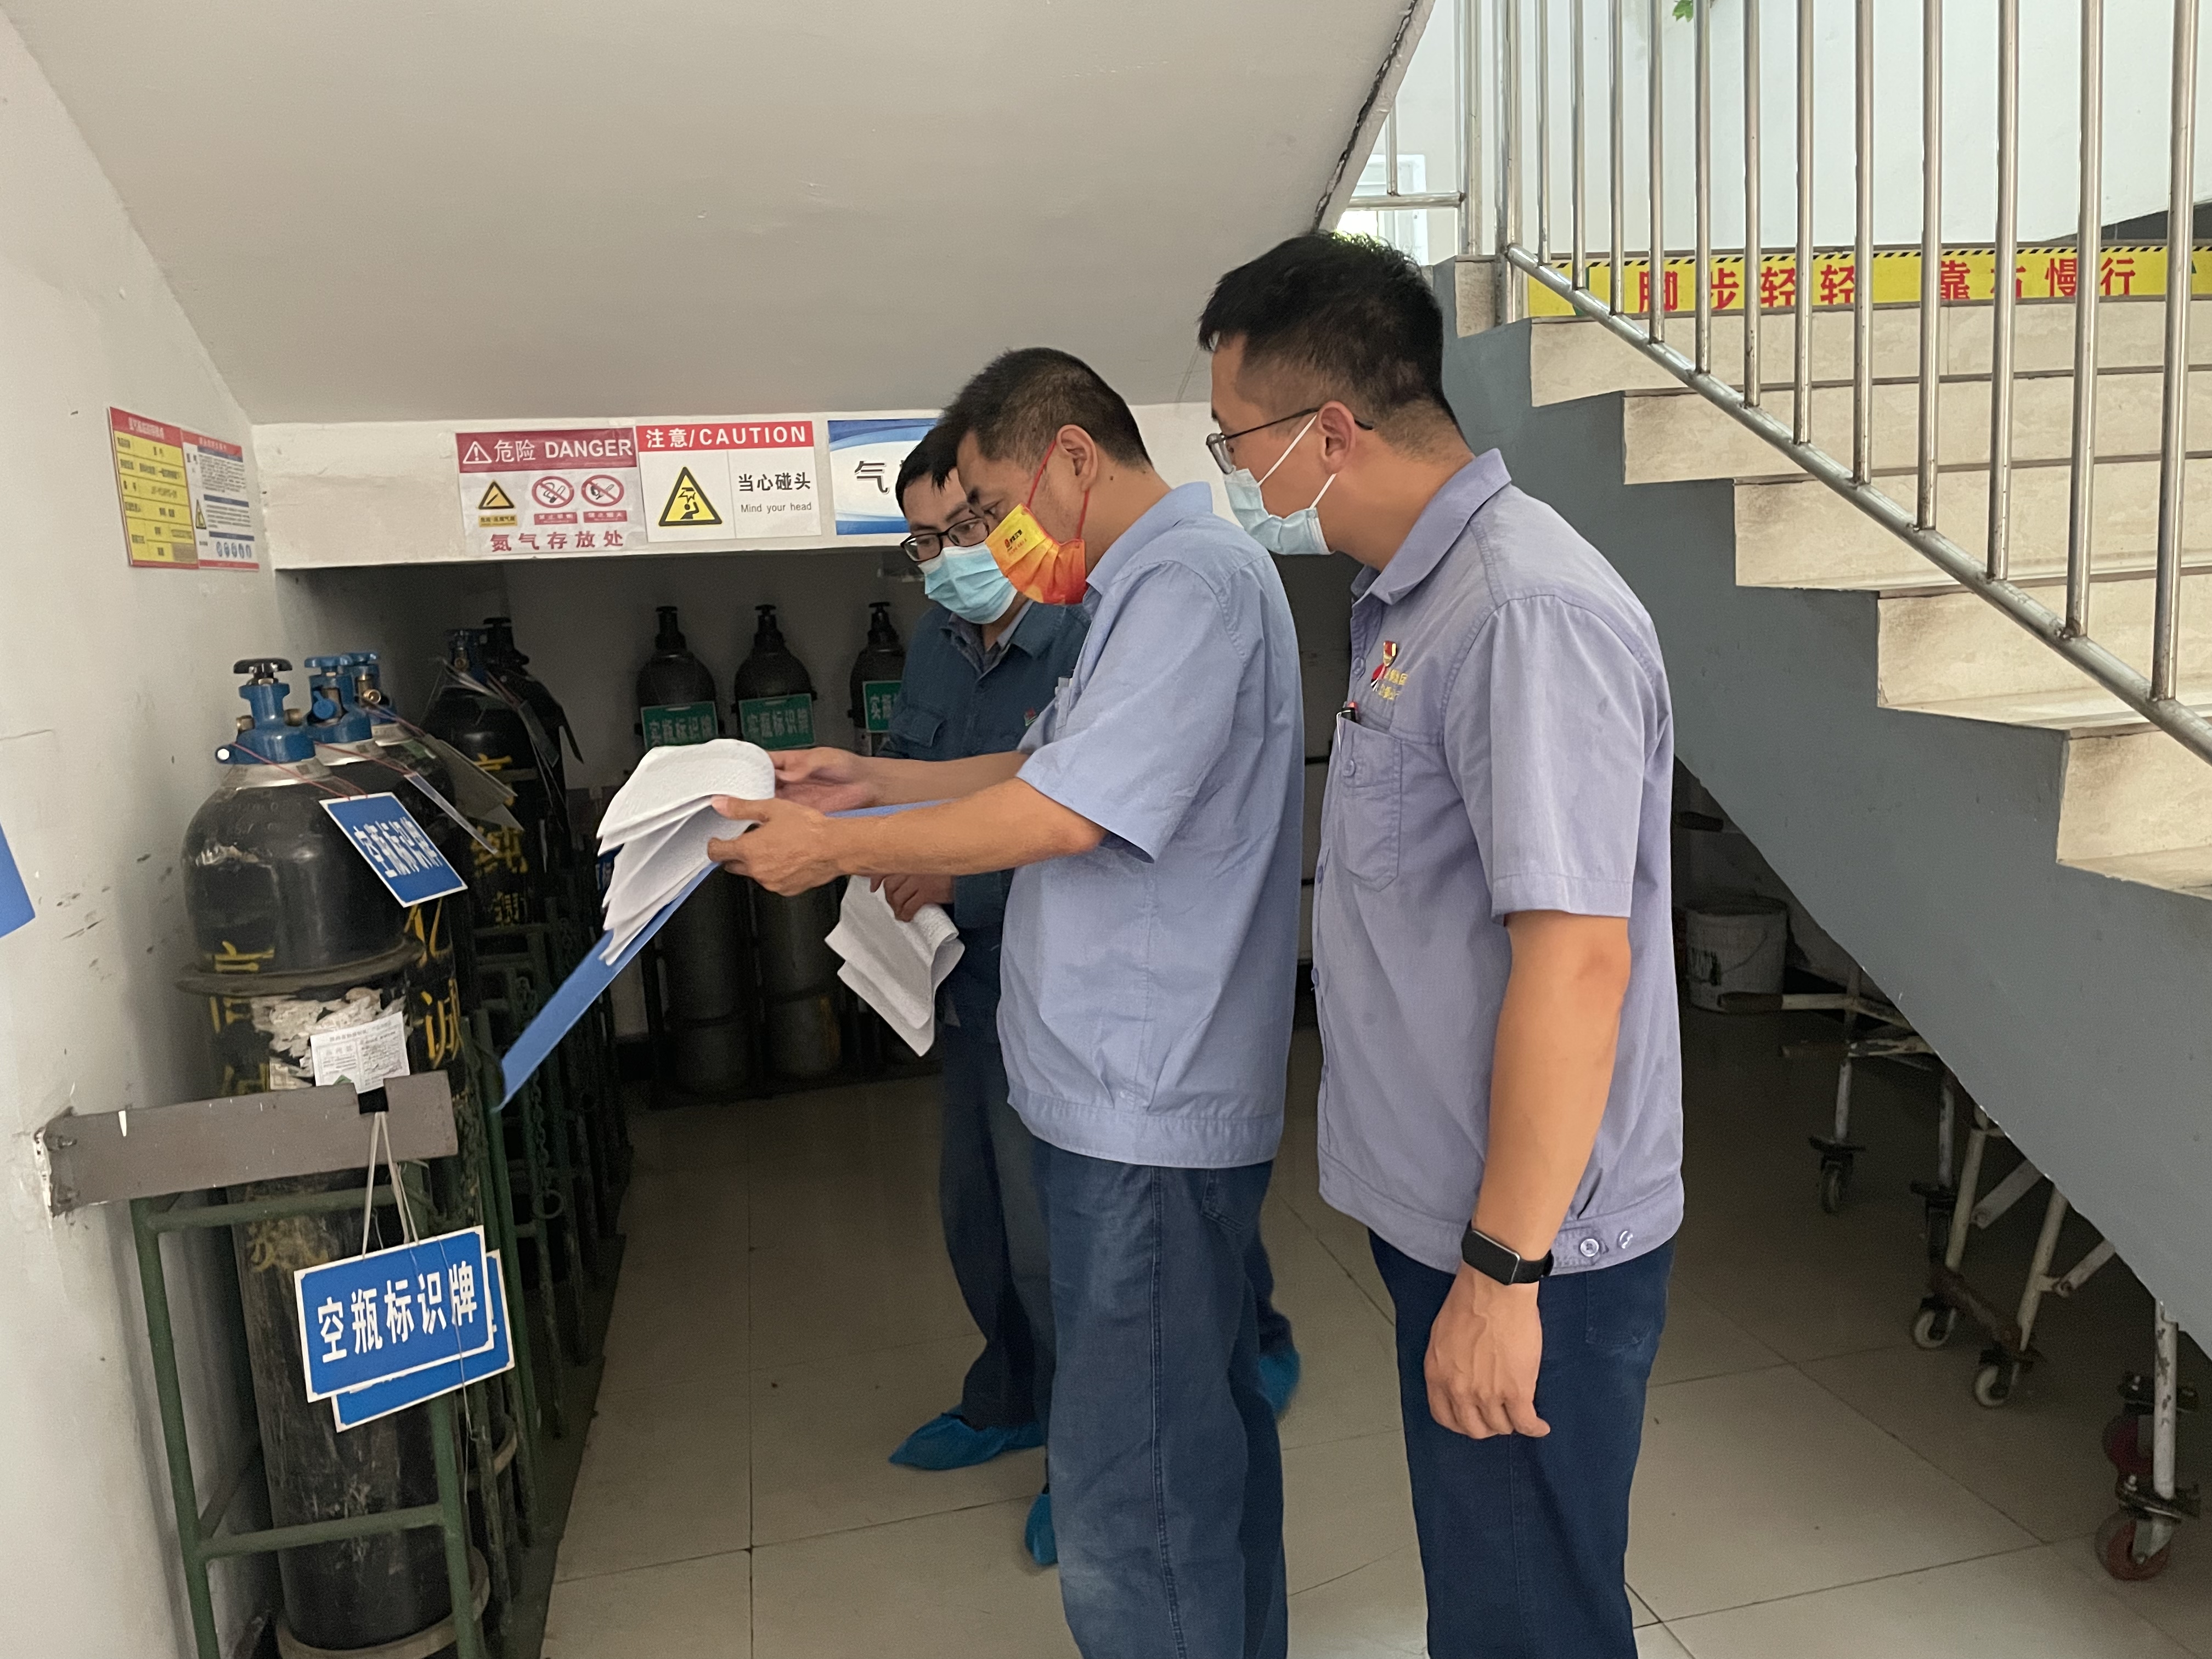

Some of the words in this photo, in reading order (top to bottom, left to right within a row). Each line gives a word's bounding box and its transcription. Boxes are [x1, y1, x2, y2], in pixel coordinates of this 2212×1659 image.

[494, 439, 535, 462] 危险
[545, 439, 633, 459] DANGER
[738, 472, 811, 492] 当心碰头
[741, 503, 762, 512] Mind
[766, 504, 786, 514] your
[790, 502, 812, 511] head
[490, 530, 623, 552] 氮气存放处
[353, 816, 443, 878] 空瓶标识牌
[318, 1261, 477, 1363] 空瓶标识牌
